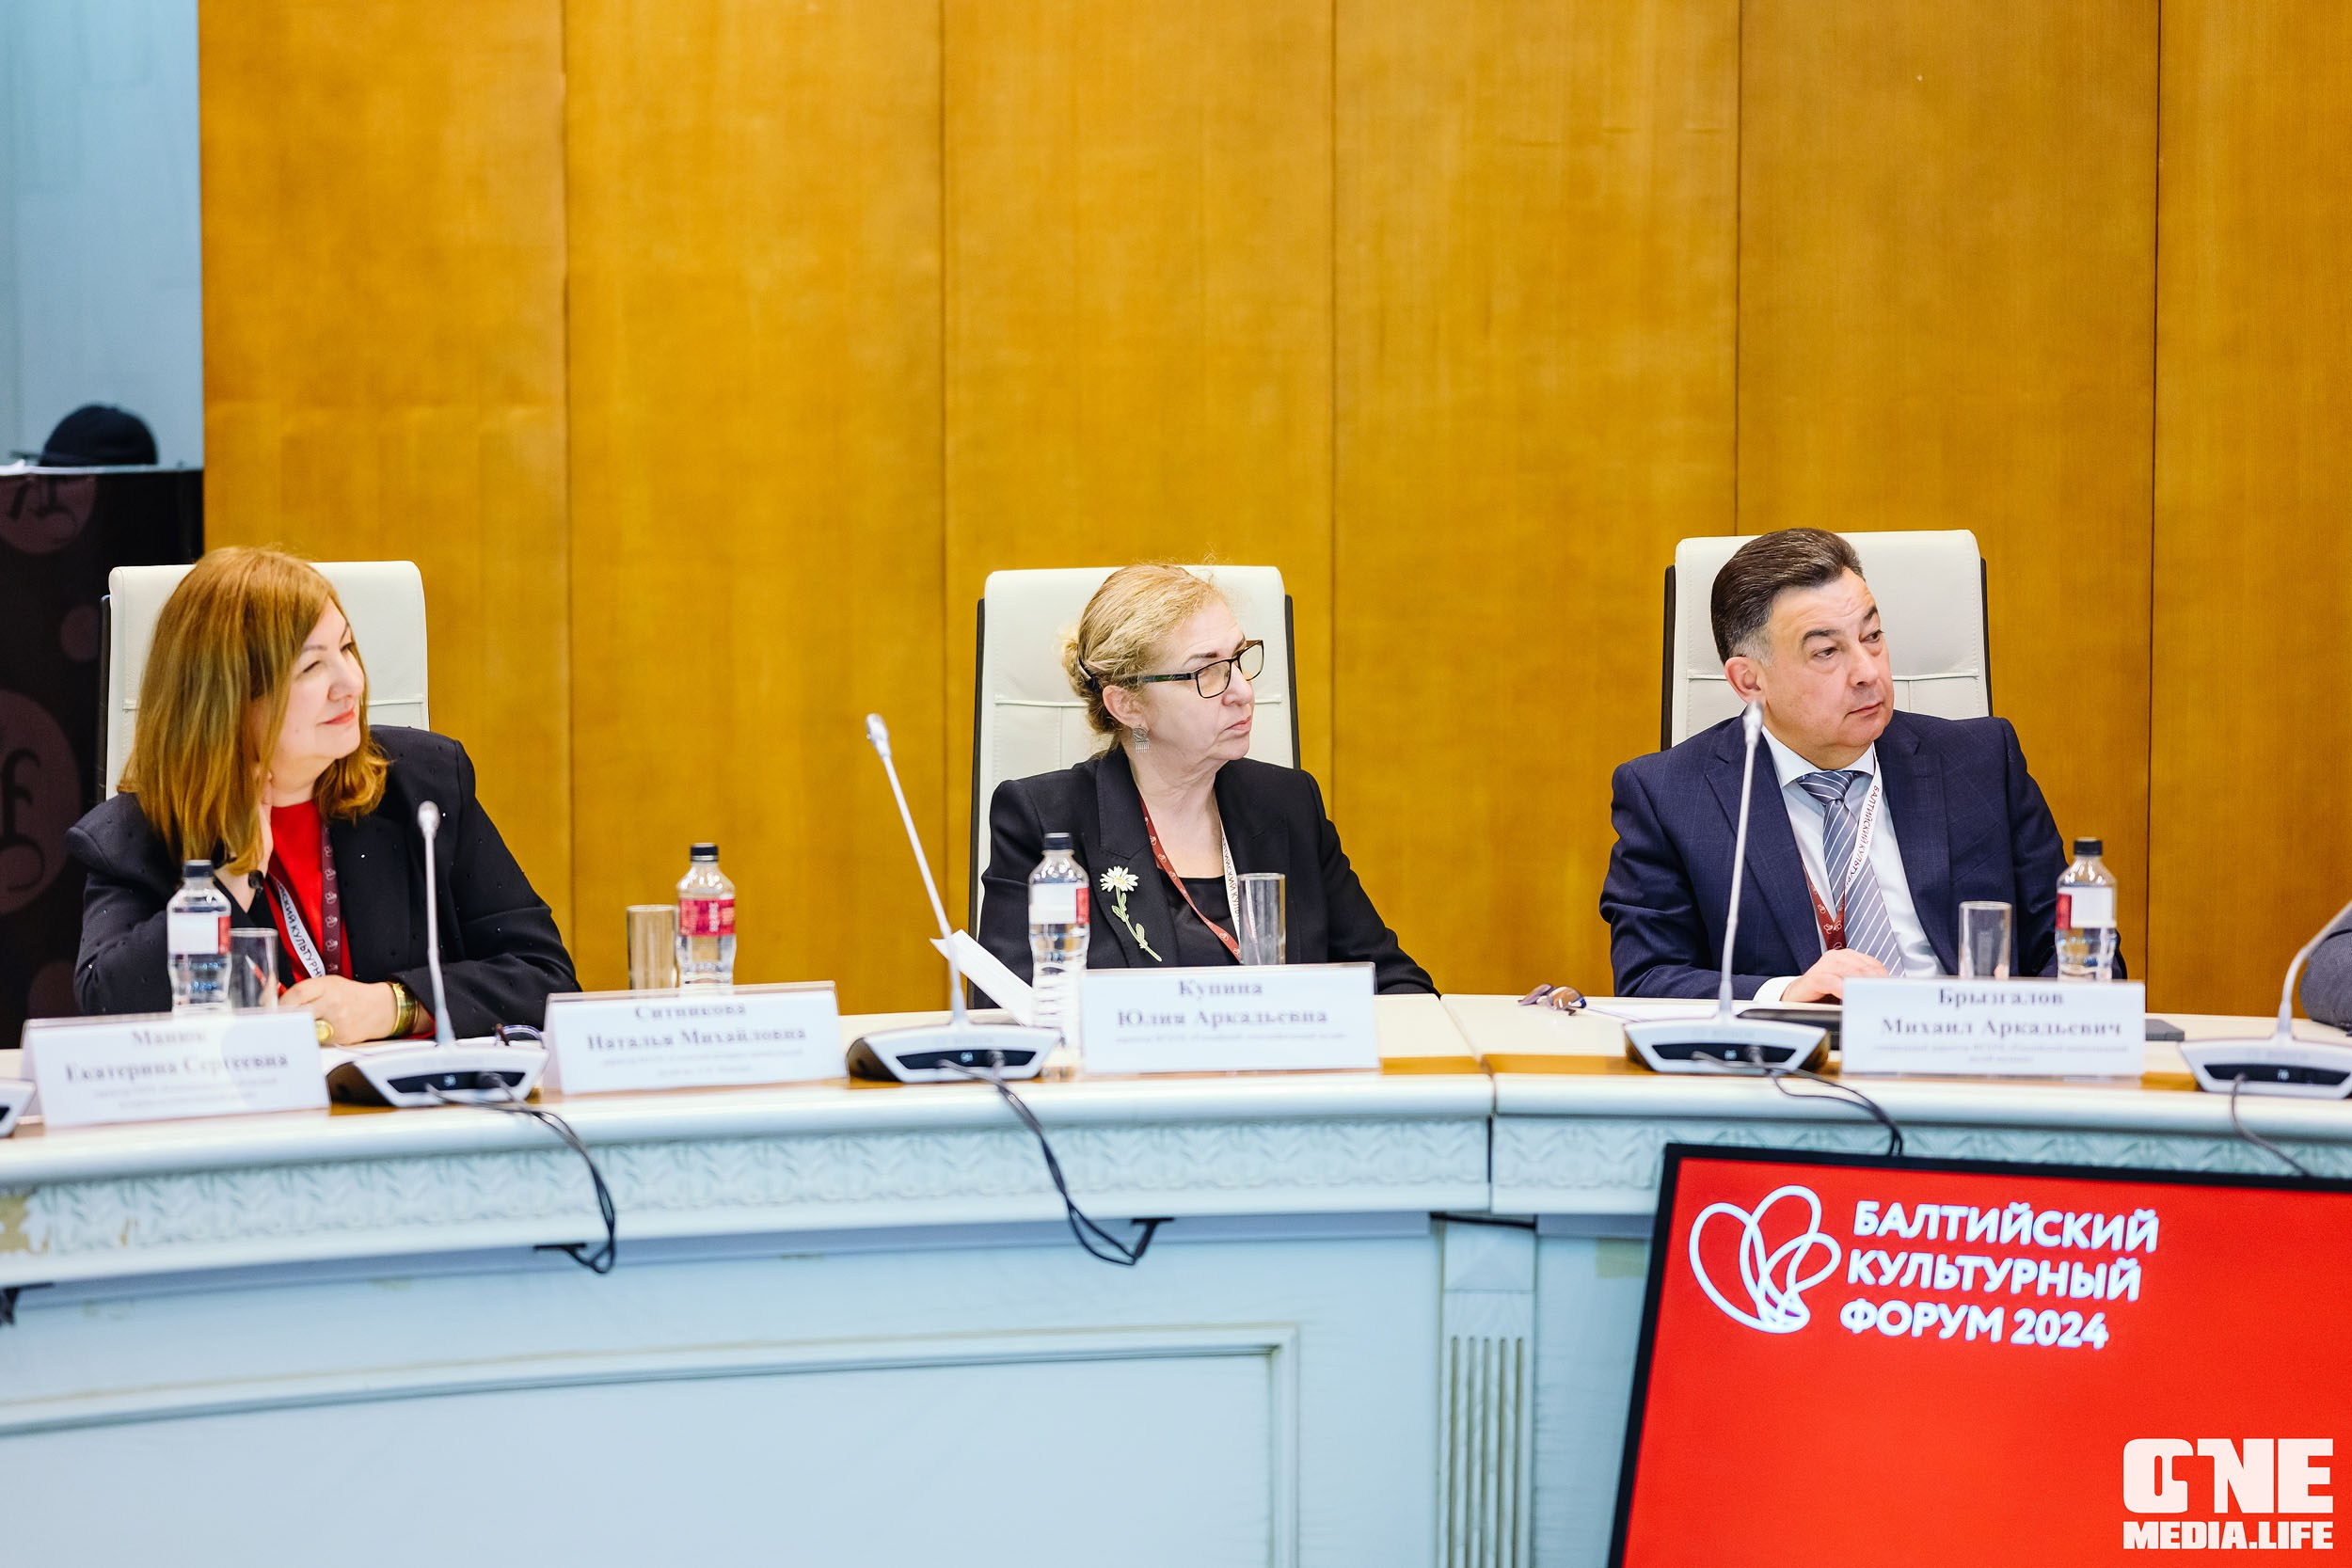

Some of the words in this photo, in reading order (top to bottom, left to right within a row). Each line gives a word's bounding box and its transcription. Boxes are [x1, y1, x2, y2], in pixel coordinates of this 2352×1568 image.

[1860, 784, 1880, 845] БАЛТИЙСКИЙ
[1846, 845, 1865, 886] КУЛЬТУР
[291, 924, 324, 978] КУЛЬТУРН
[1178, 979, 1263, 1001] Купина
[1117, 1009, 1186, 1028] Юлия
[1882, 1017, 1973, 1036] Михаил
[1853, 1200, 2159, 1253] БАЛТИЙСКИЙ
[1847, 1248, 2142, 1302] КУЛЬТУРНЫЙ
[1840, 1298, 2005, 1343] ФОРУМ
[2010, 1307, 2109, 1350] 2024
